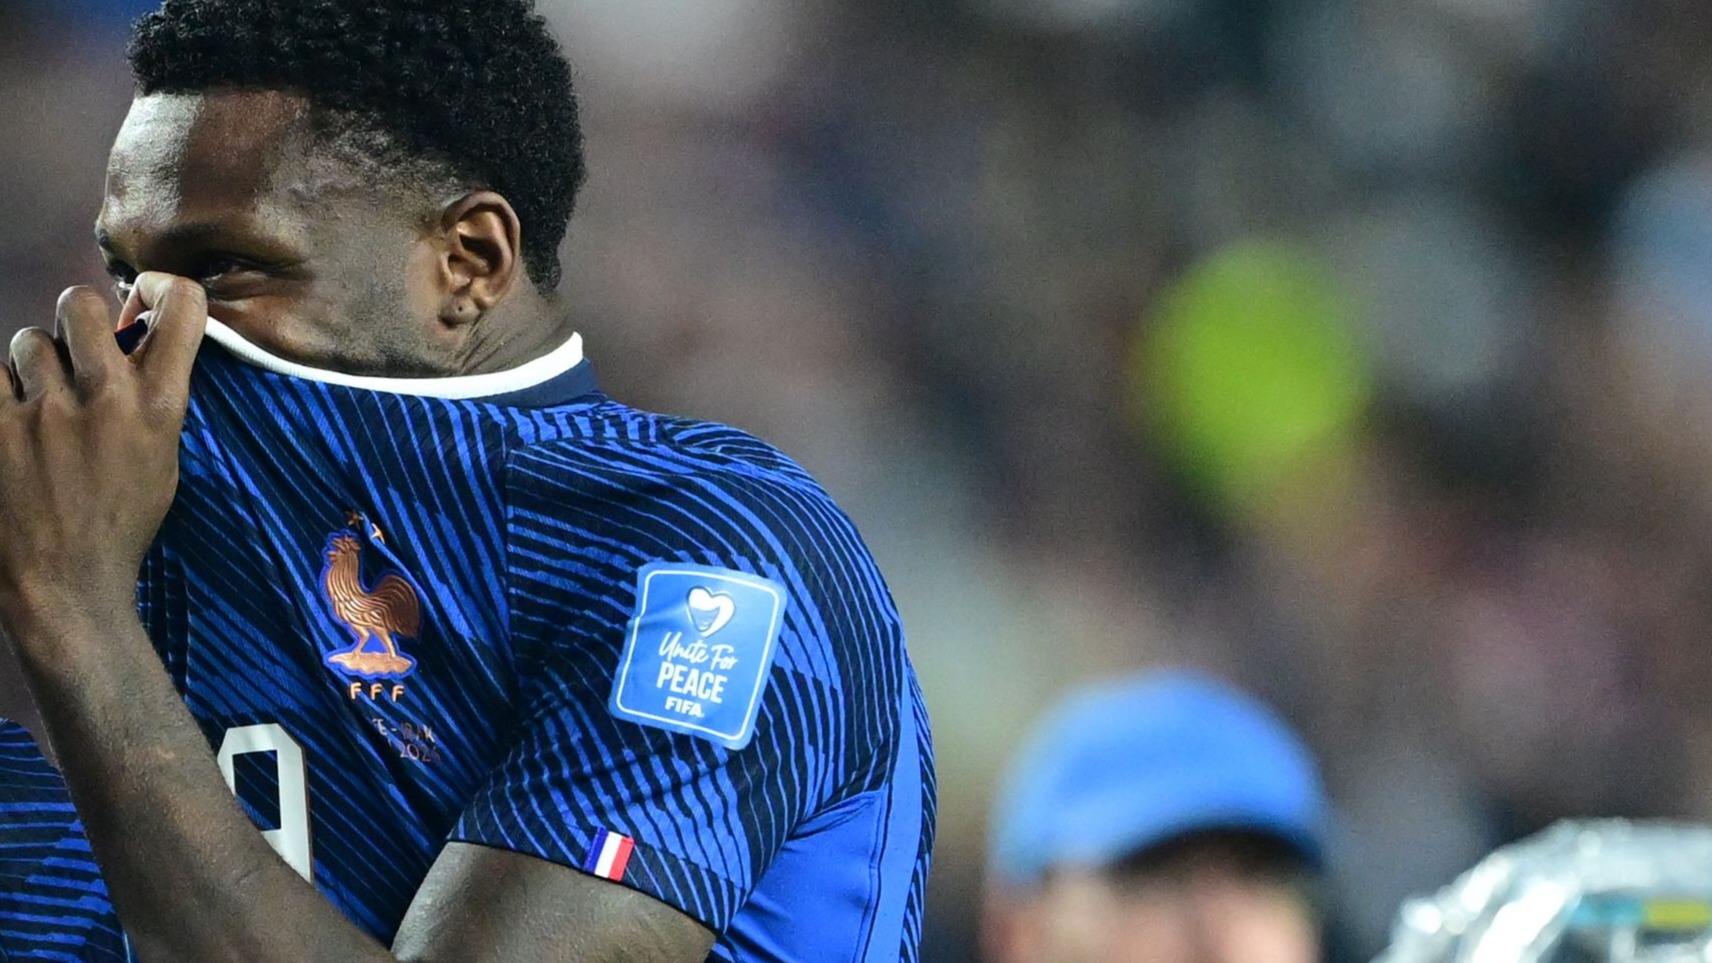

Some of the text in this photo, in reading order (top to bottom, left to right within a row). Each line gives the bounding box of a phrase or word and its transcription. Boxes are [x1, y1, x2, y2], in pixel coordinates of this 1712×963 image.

[659, 632, 738, 671] Unite For
[656, 661, 728, 704] PEACE
[664, 696, 705, 718] FIFA
